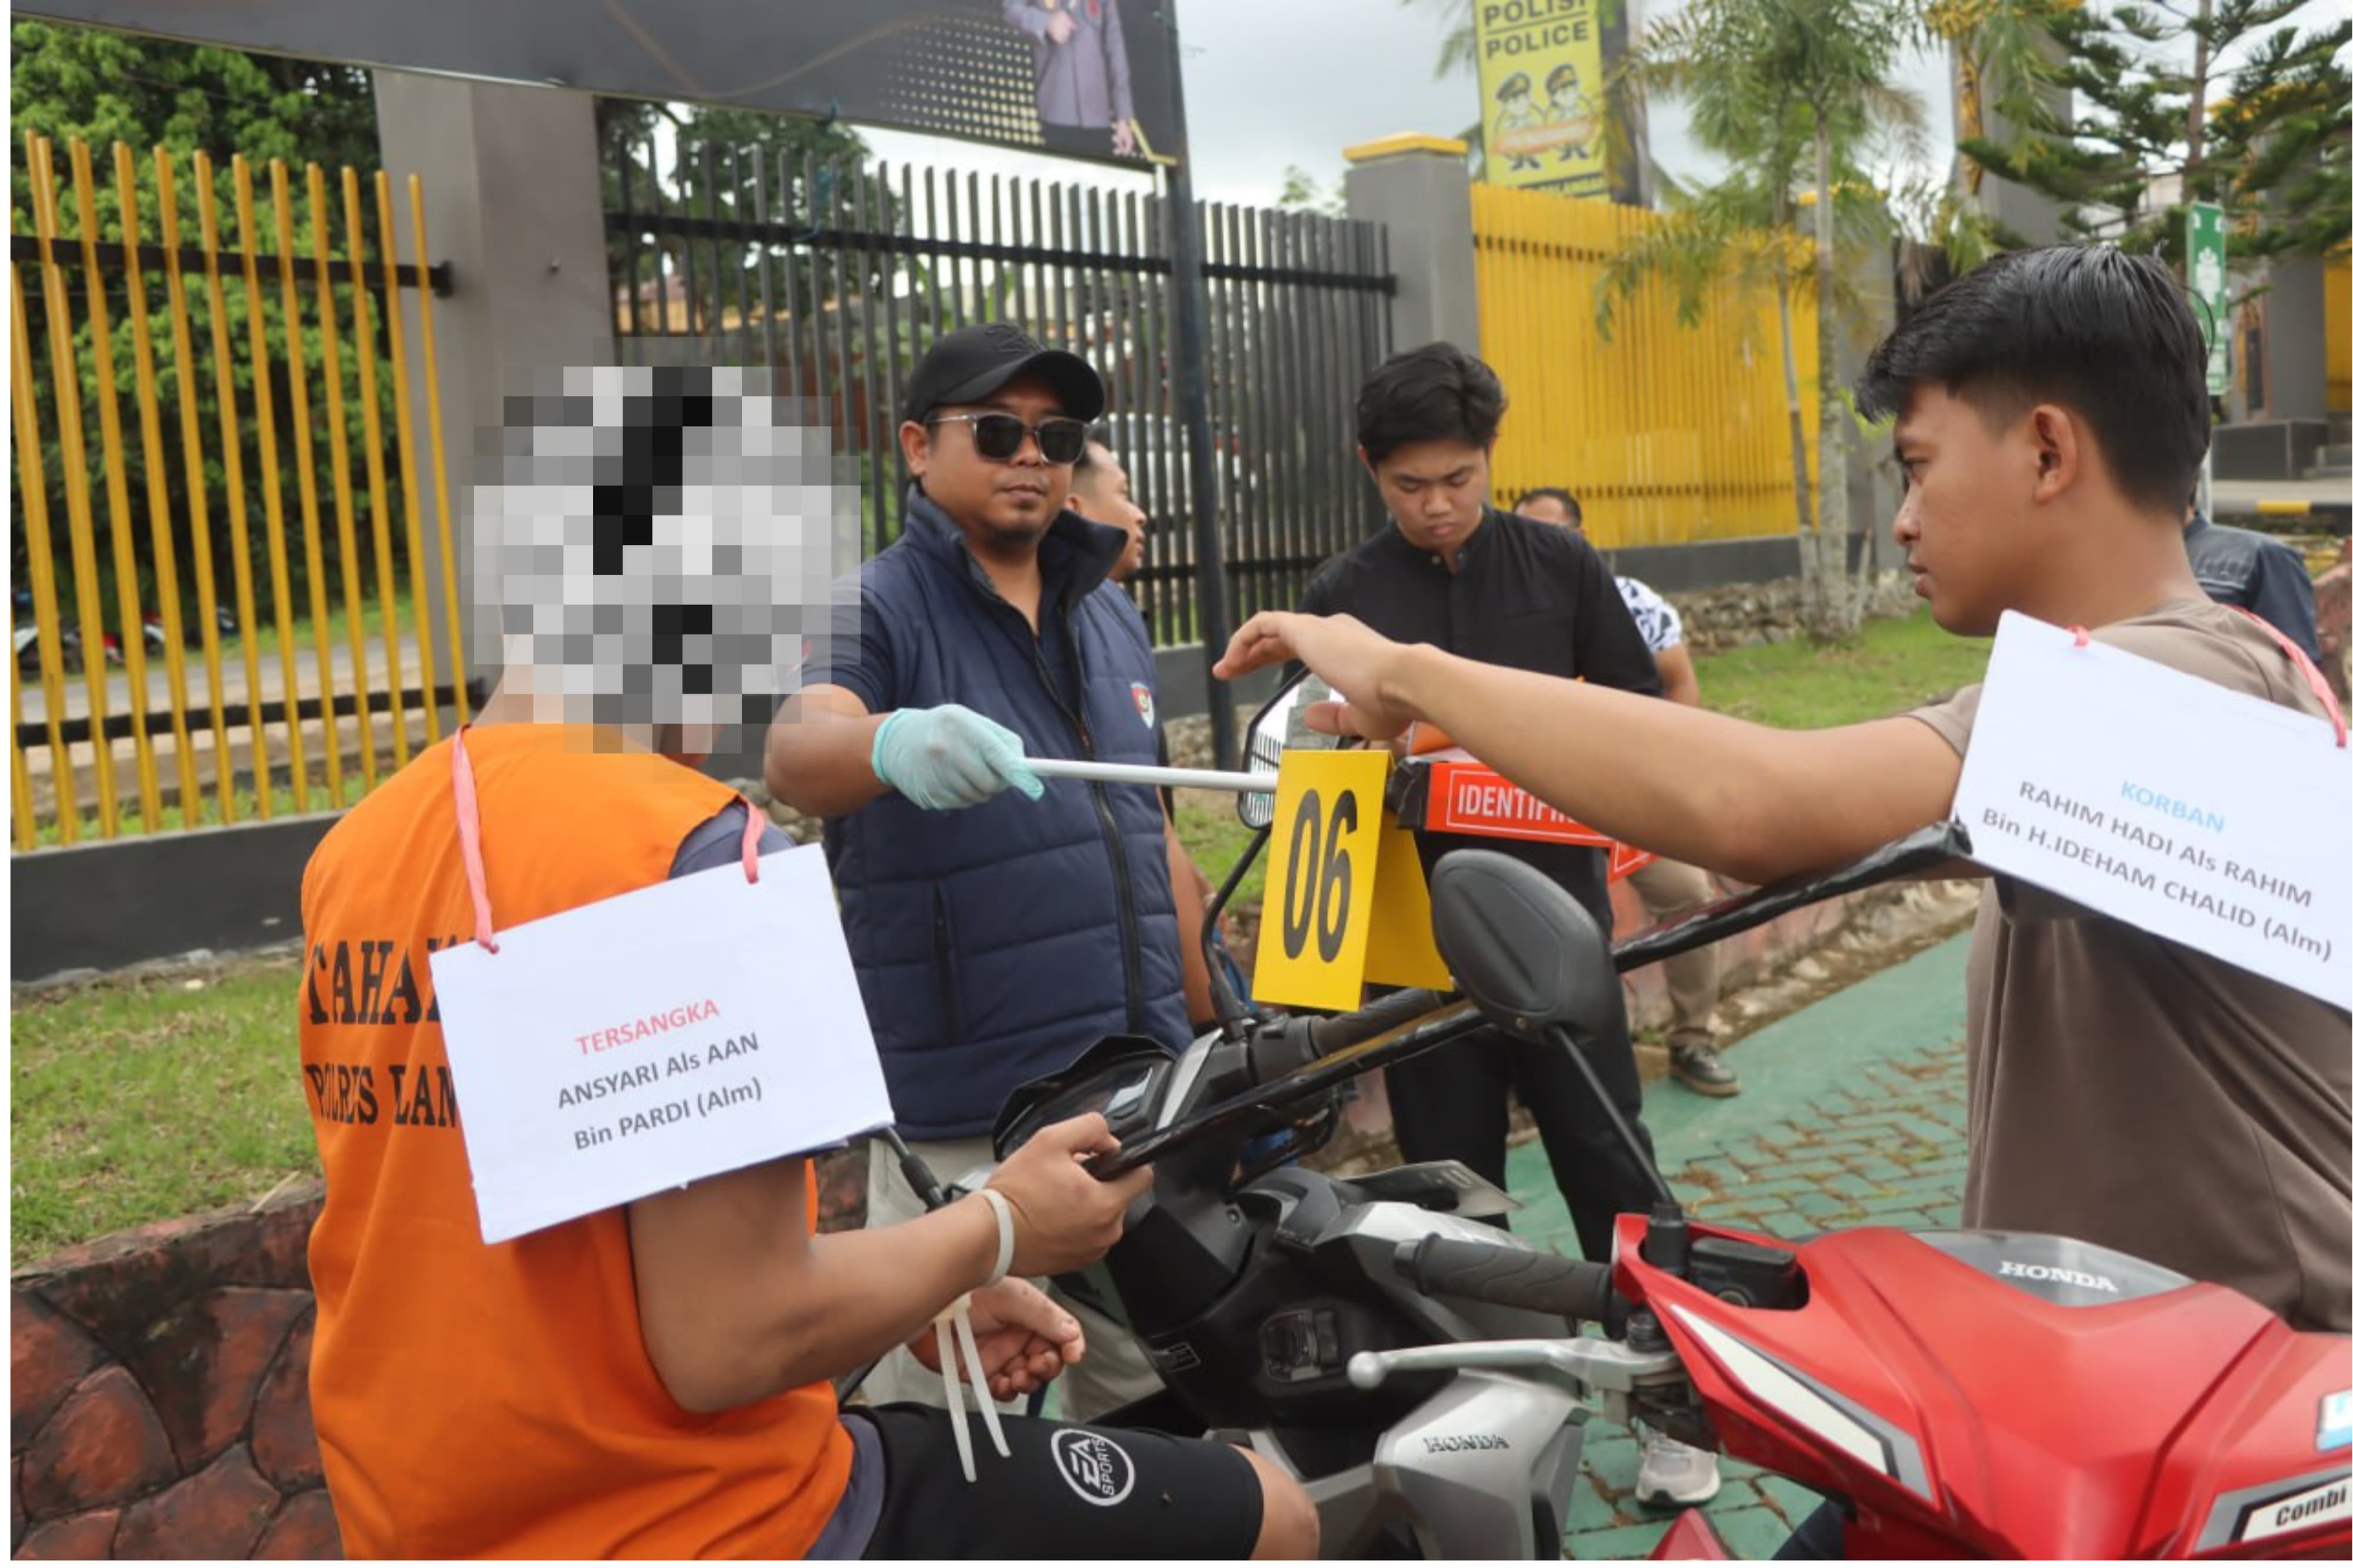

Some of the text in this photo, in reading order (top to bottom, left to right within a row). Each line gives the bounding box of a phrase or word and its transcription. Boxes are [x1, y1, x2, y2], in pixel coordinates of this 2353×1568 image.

[1484, 0, 1587, 26] POLIS
[1486, 21, 1589, 59] POLICE
[1457, 783, 1578, 823] IDENTIF
[2121, 780, 2225, 833] KORBAN
[2018, 781, 2312, 908] RAHIM HADI Als RAHIM
[1282, 789, 1358, 963] 06
[1981, 808, 2332, 963] Bin H.IDEHAM CHALID (Alm)
[307, 936, 478, 1025] TAHA
[575, 998, 720, 1055] TERSANGKA
[558, 1031, 759, 1109] ANSYARI Als AAN
[574, 1076, 762, 1150] Bin PARDI (Alm)
[1999, 1260, 2119, 1293] HONDA
[1068, 1439, 1101, 1490] EA
[1092, 1437, 1115, 1496] SPORTS
[1422, 1433, 1510, 1453] HONDA
[2275, 1484, 2347, 1527] Combi
